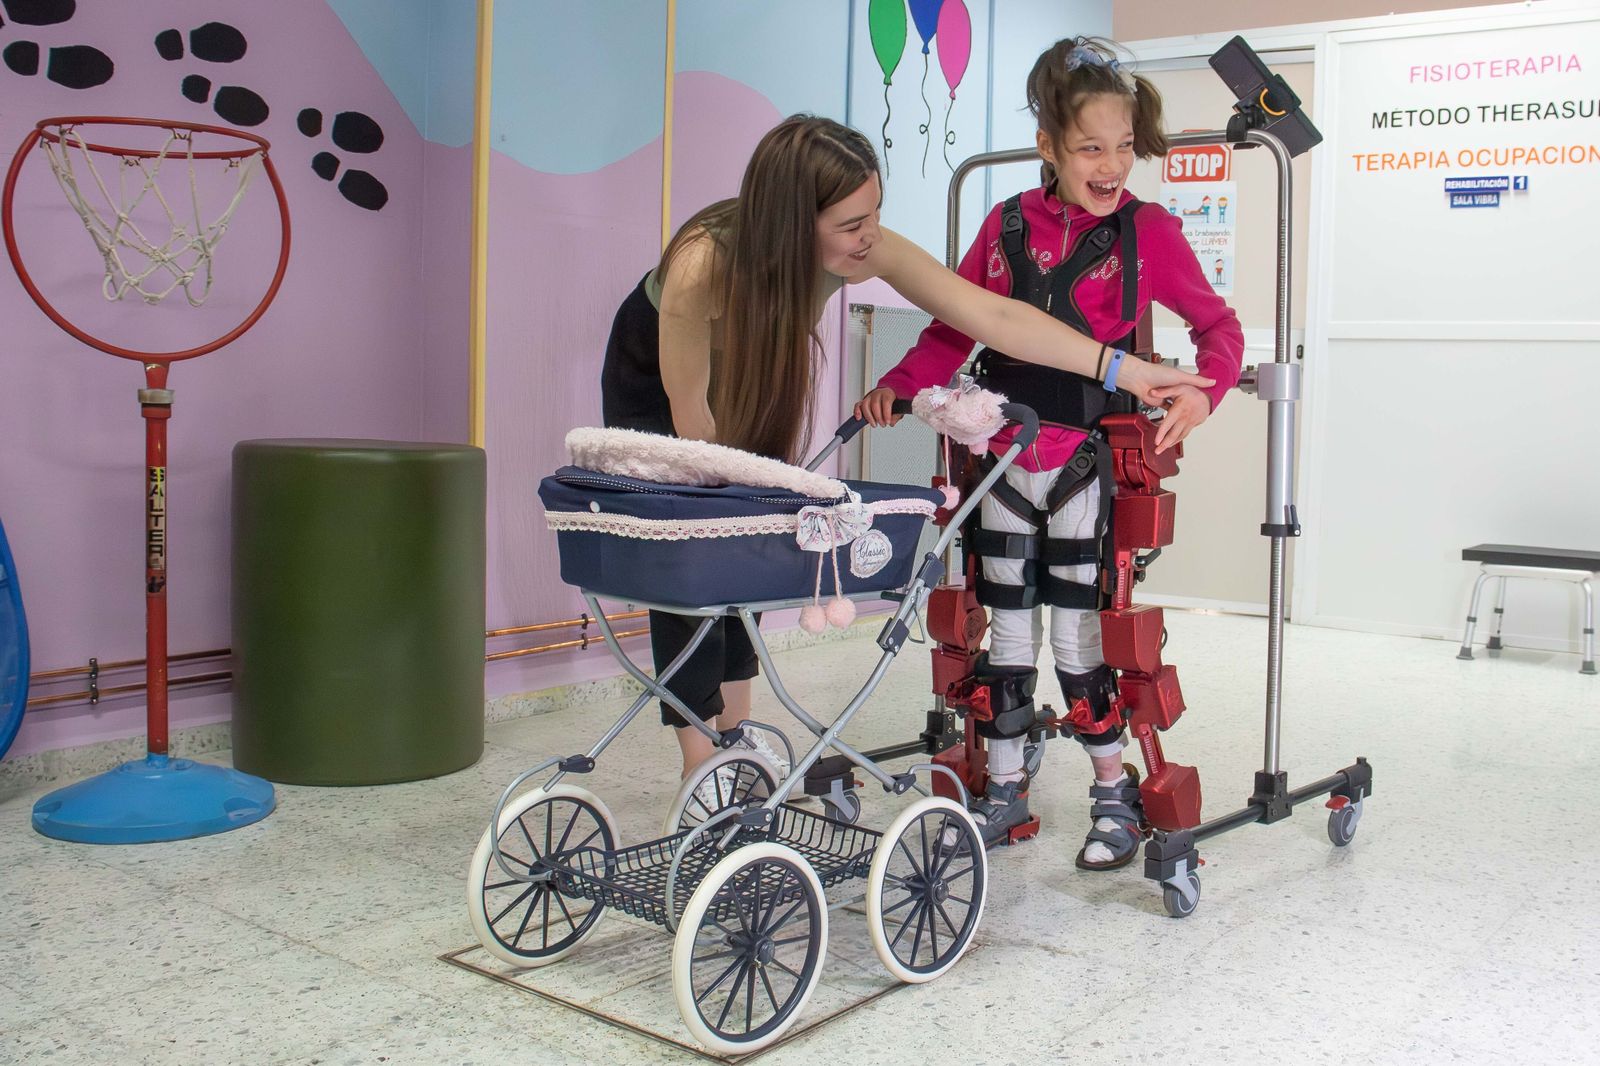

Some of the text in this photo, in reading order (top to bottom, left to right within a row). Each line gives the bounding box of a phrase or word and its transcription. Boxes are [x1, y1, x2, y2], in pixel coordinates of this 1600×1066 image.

[1409, 54, 1582, 83] FISIOTERAPIA
[1372, 99, 1600, 129] MÉTODO THERASU
[1169, 153, 1223, 178] STOP
[1352, 150, 1450, 172] TERAPIA
[1516, 176, 1525, 189] 1
[1453, 195, 1473, 206] SALA
